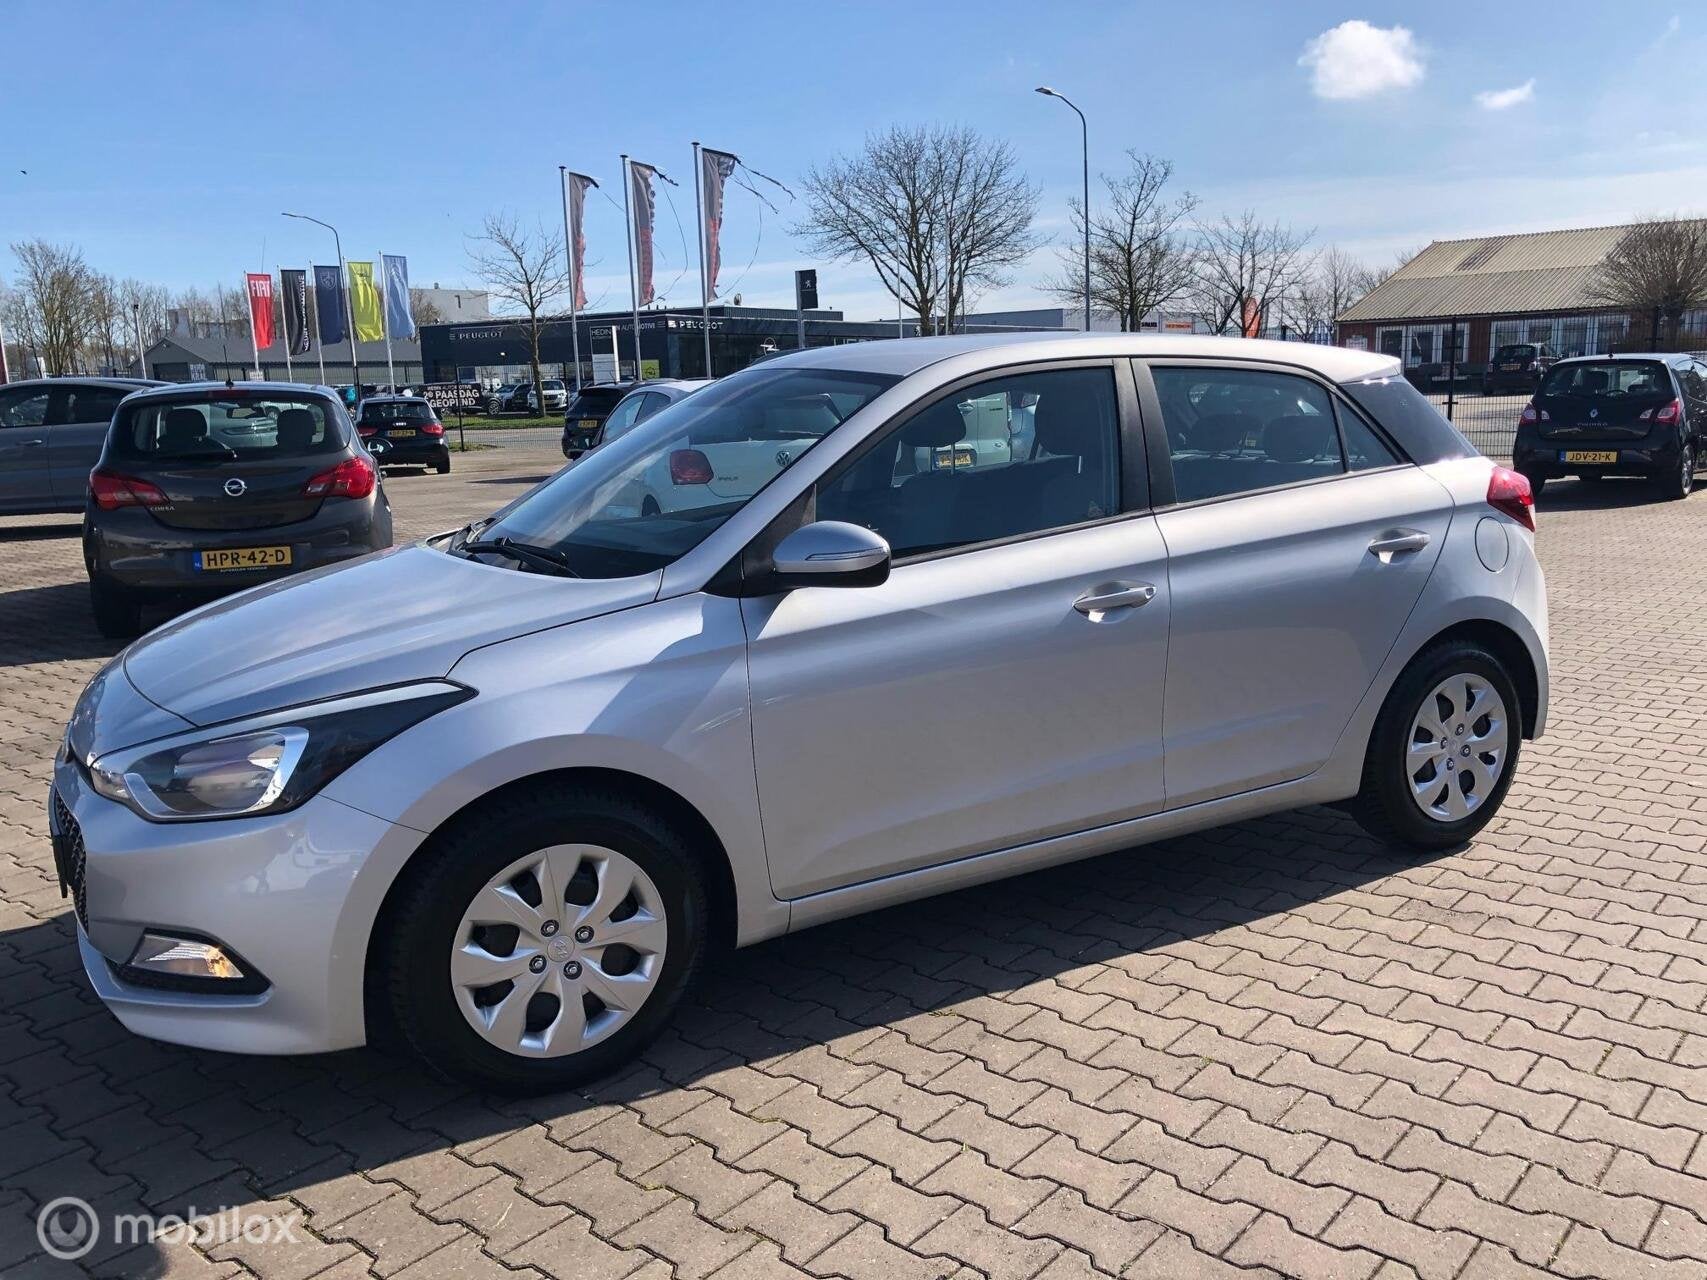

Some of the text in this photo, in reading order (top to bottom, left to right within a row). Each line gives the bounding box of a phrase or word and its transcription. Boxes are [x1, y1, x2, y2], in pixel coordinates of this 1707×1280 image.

[250, 280, 270, 297] FIAT
[621, 322, 656, 331] AUTOOTIVE
[679, 320, 724, 330] PEUGEOT
[459, 331, 503, 340] PEUGEOT
[435, 389, 480, 399] PAASDAG
[1569, 452, 1611, 461] JDV-21-K
[206, 549, 286, 567] HPR-42-D
